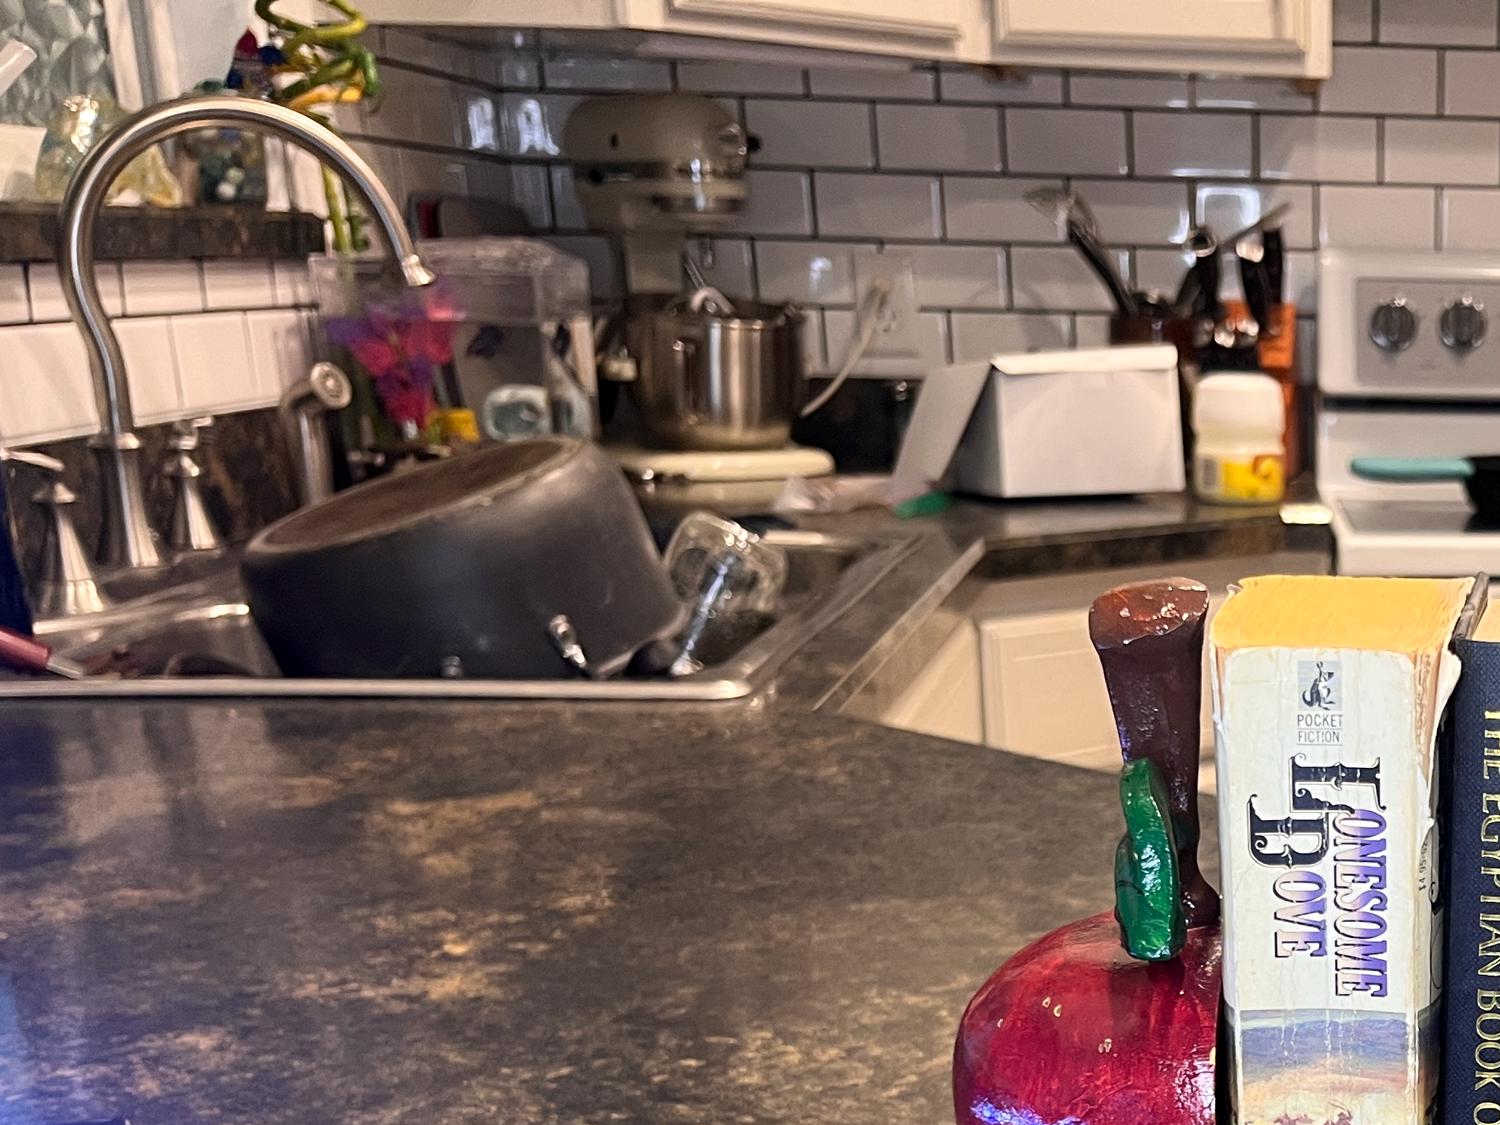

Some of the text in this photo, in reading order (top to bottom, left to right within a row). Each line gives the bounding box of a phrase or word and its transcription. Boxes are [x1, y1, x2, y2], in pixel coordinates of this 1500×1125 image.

[1297, 714, 1343, 728] POCKET
[1298, 730, 1340, 743] FICTION
[1289, 752, 1388, 998] LONESOME
